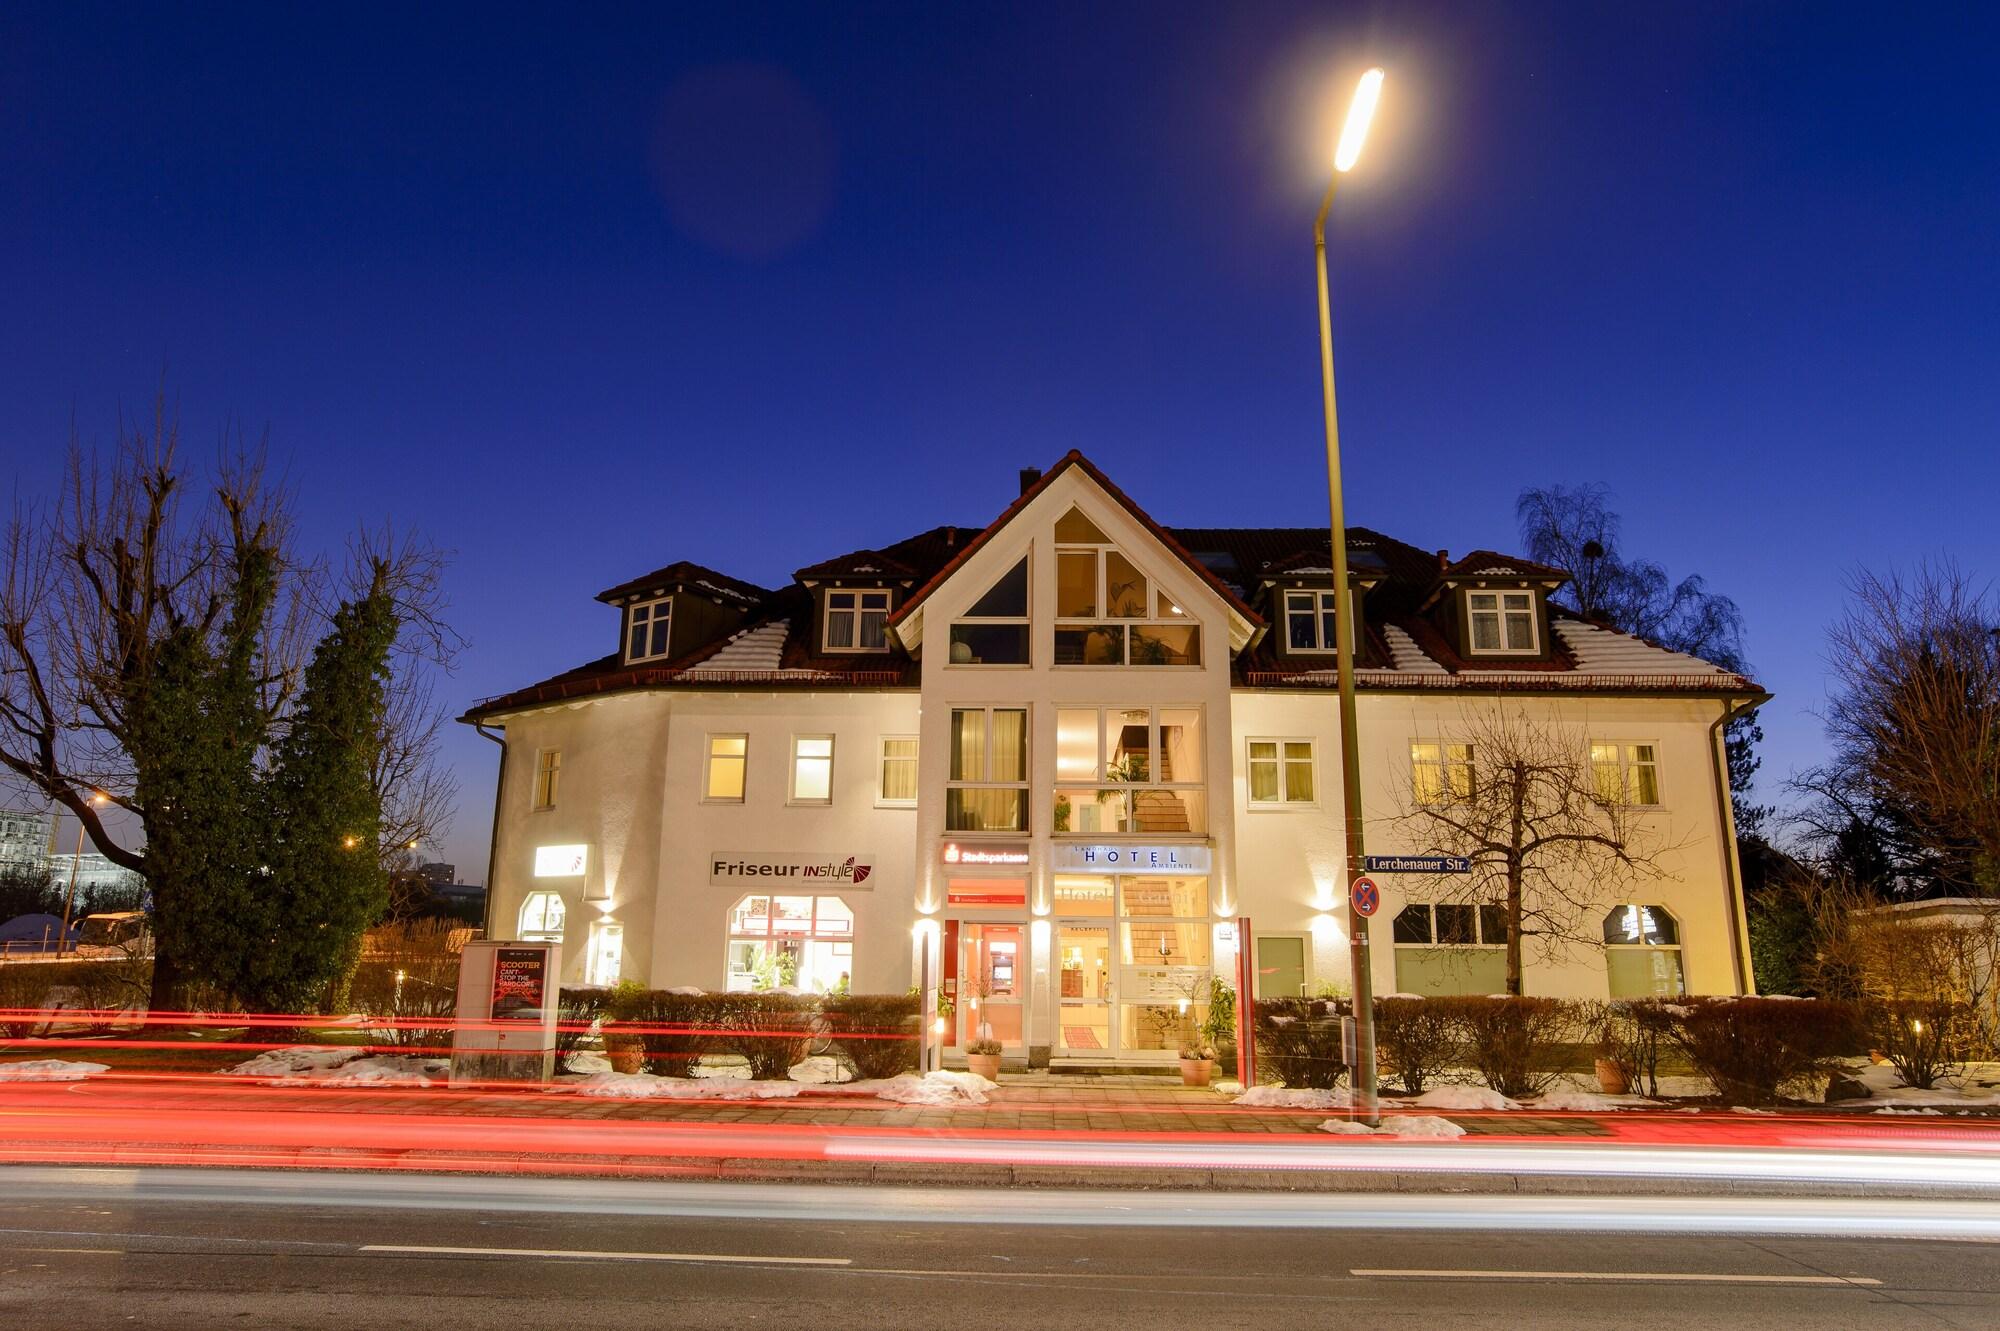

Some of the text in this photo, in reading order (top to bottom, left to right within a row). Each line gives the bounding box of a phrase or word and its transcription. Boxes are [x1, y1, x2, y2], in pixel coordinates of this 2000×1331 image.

[1085, 851, 1177, 863] HOTEL
[713, 861, 799, 876] Friseur
[1372, 858, 1466, 870] Lerchenauer Str.
[1061, 887, 1108, 900] Hotel
